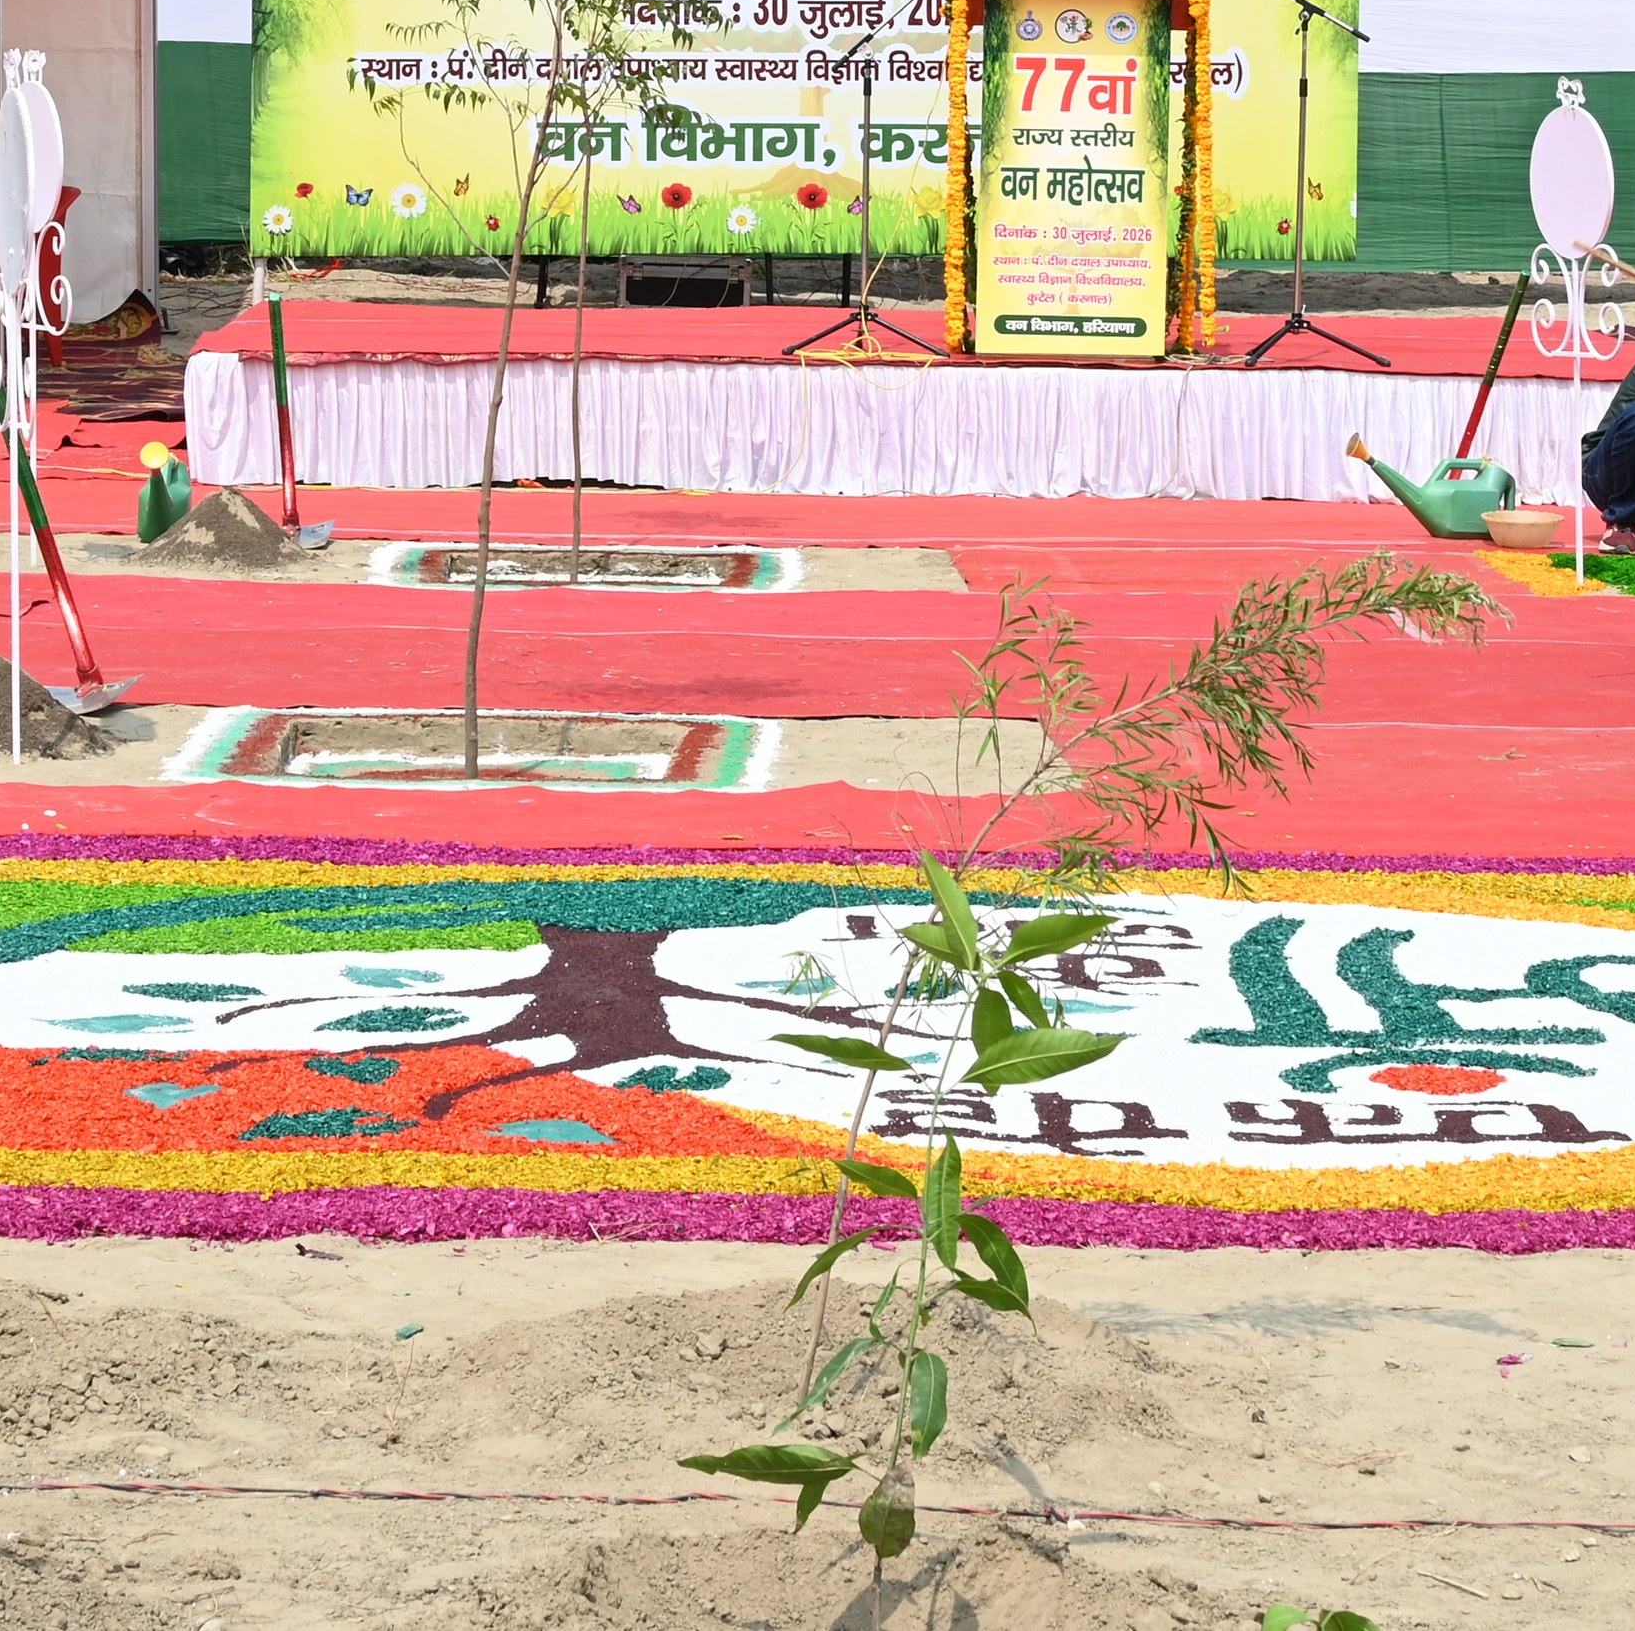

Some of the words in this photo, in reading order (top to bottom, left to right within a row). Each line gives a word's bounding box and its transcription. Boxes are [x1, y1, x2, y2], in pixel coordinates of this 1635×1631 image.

[361, 58, 422, 80] स्थान
[715, 59, 798, 82] स्वास्थ्य
[1016, 57, 1137, 115] 77वां
[1013, 128, 1064, 146] राज्य
[1070, 122, 1135, 147] स्तरीय
[1001, 167, 1039, 200] वन
[1047, 154, 1145, 206] महोत्सव
[994, 224, 1038, 239] दिनांक
[1052, 226, 1067, 239] 30
[1122, 228, 1152, 241] 2026
[1005, 320, 1028, 331] वन
[1082, 320, 1136, 334] हरियाणा
